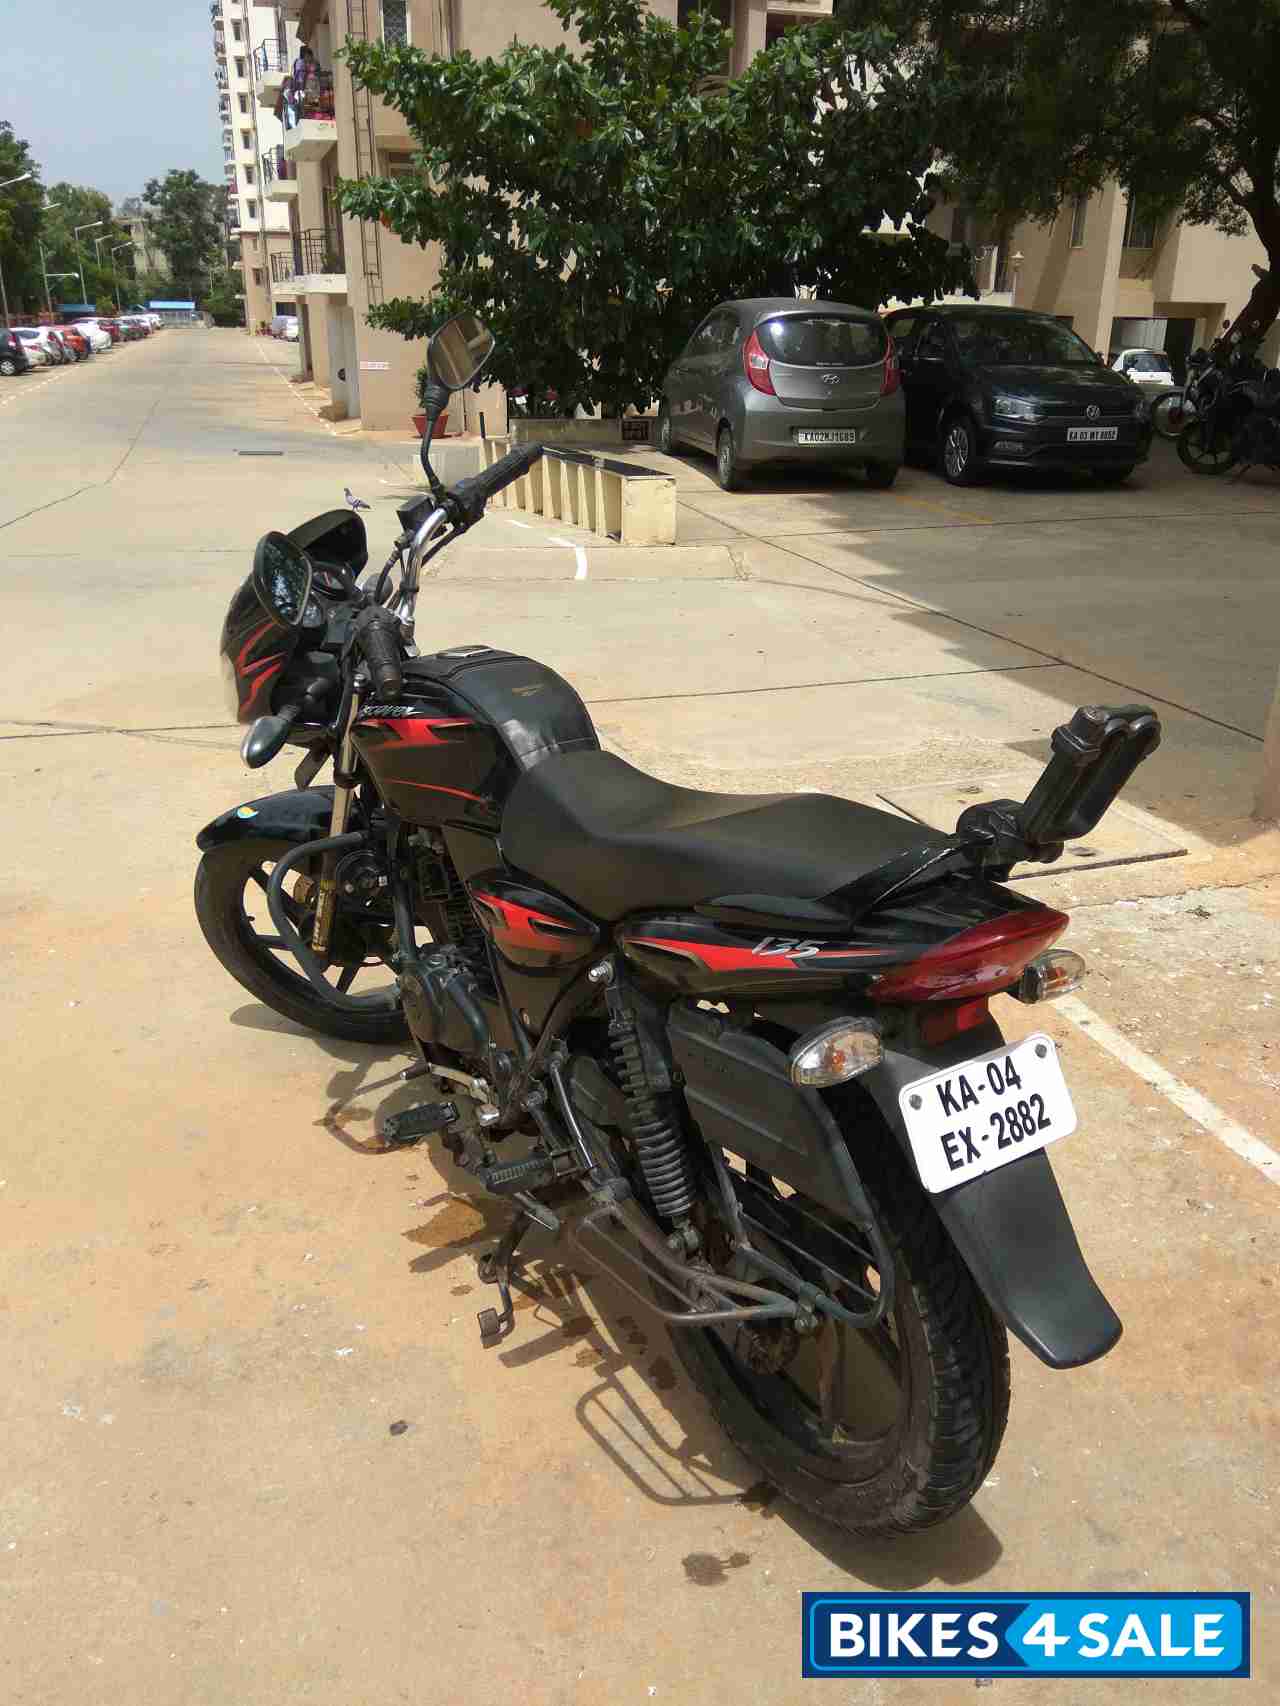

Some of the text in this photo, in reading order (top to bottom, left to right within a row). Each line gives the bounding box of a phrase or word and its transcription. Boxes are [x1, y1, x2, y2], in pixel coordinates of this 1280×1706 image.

[752, 936, 825, 959] 135
[936, 1055, 1022, 1117] KA-04
[940, 1093, 1052, 1171] EX-2882
